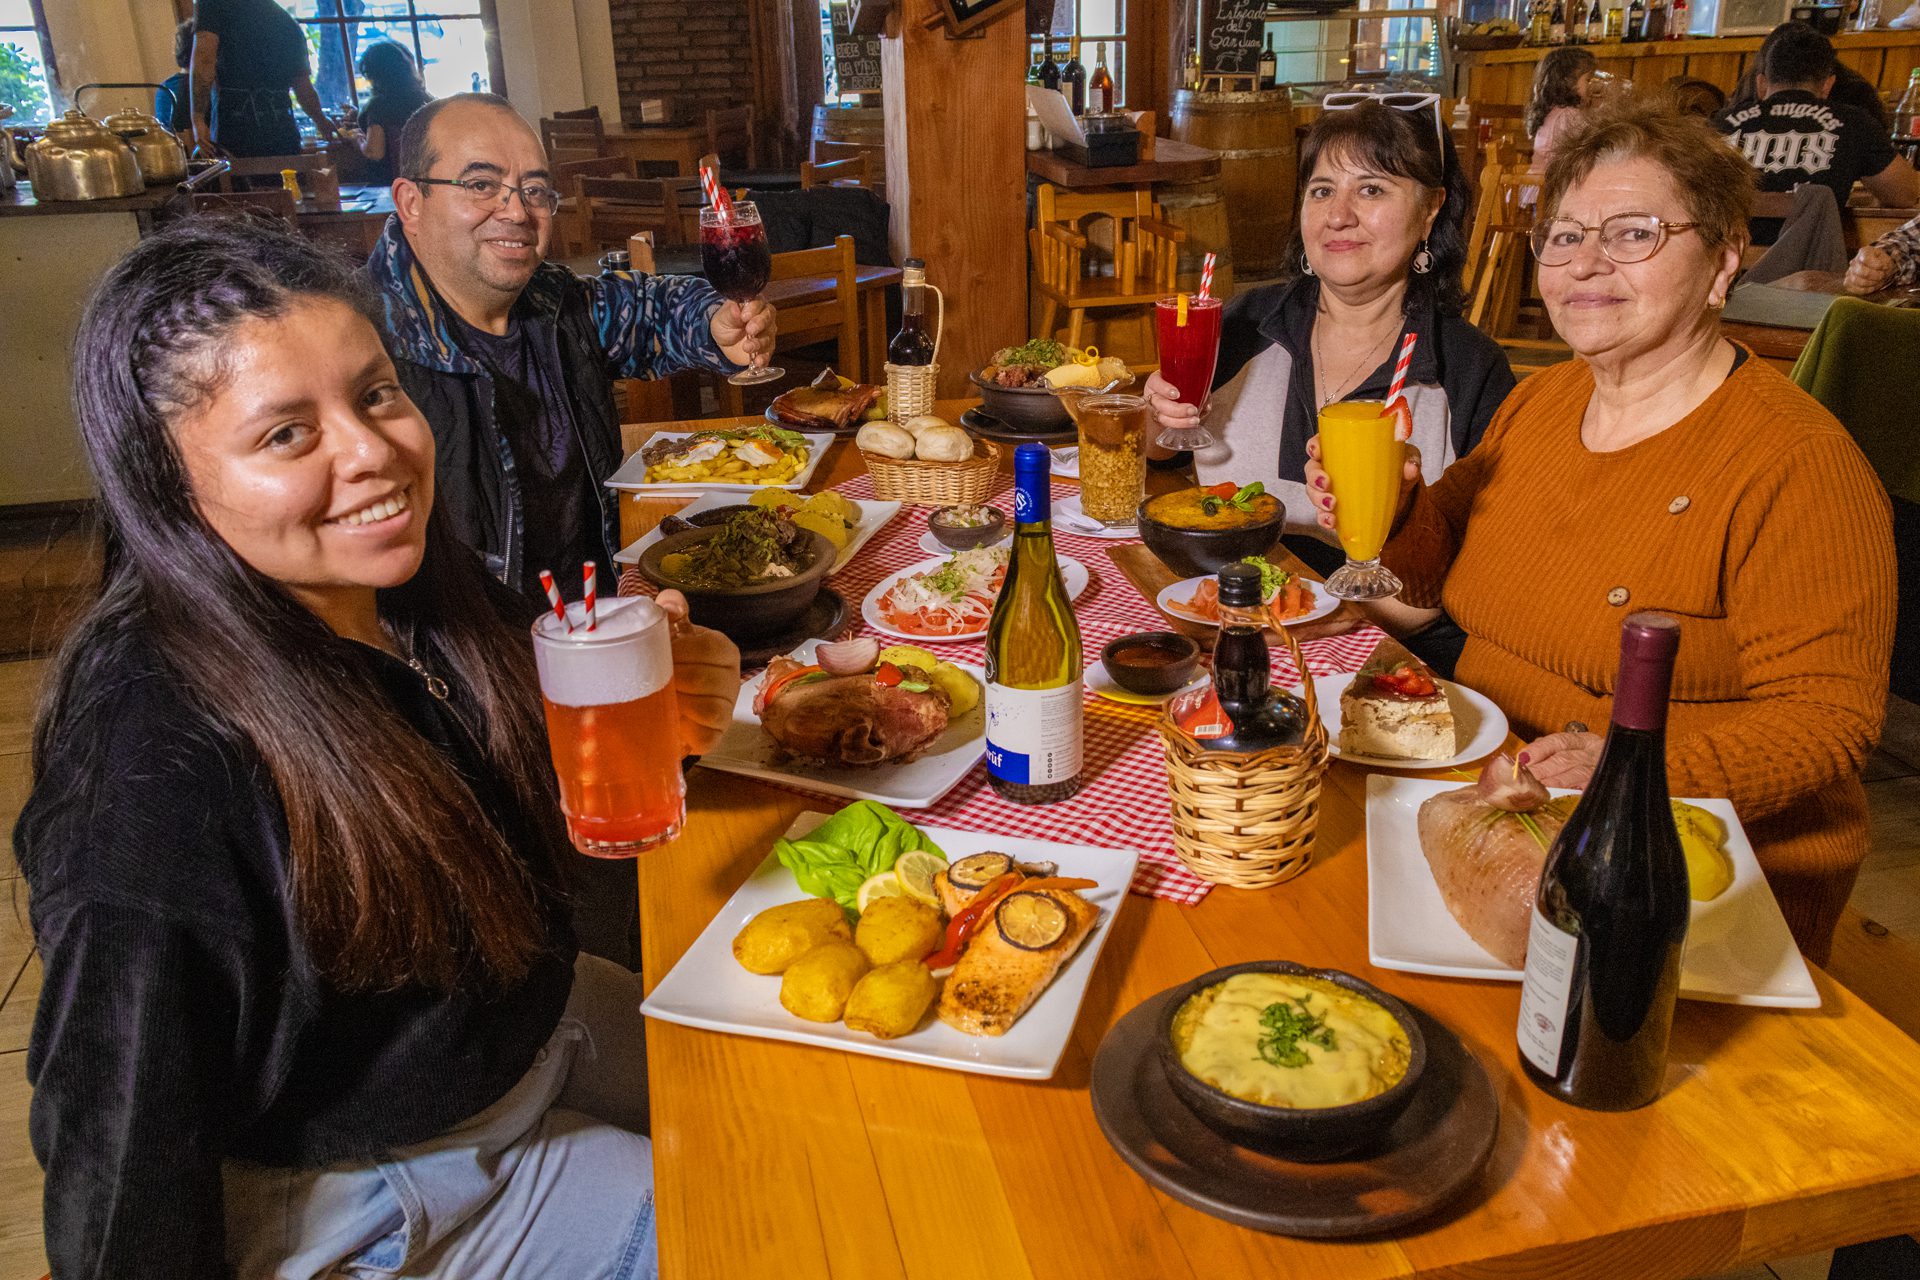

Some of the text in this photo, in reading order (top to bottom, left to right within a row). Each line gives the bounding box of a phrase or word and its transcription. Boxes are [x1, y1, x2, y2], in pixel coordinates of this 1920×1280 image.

[1209, 22, 1261, 50] San Juan
[840, 61, 853, 76] LA
[1725, 103, 1844, 131] los angeles
[1724, 129, 1840, 175] 1998
